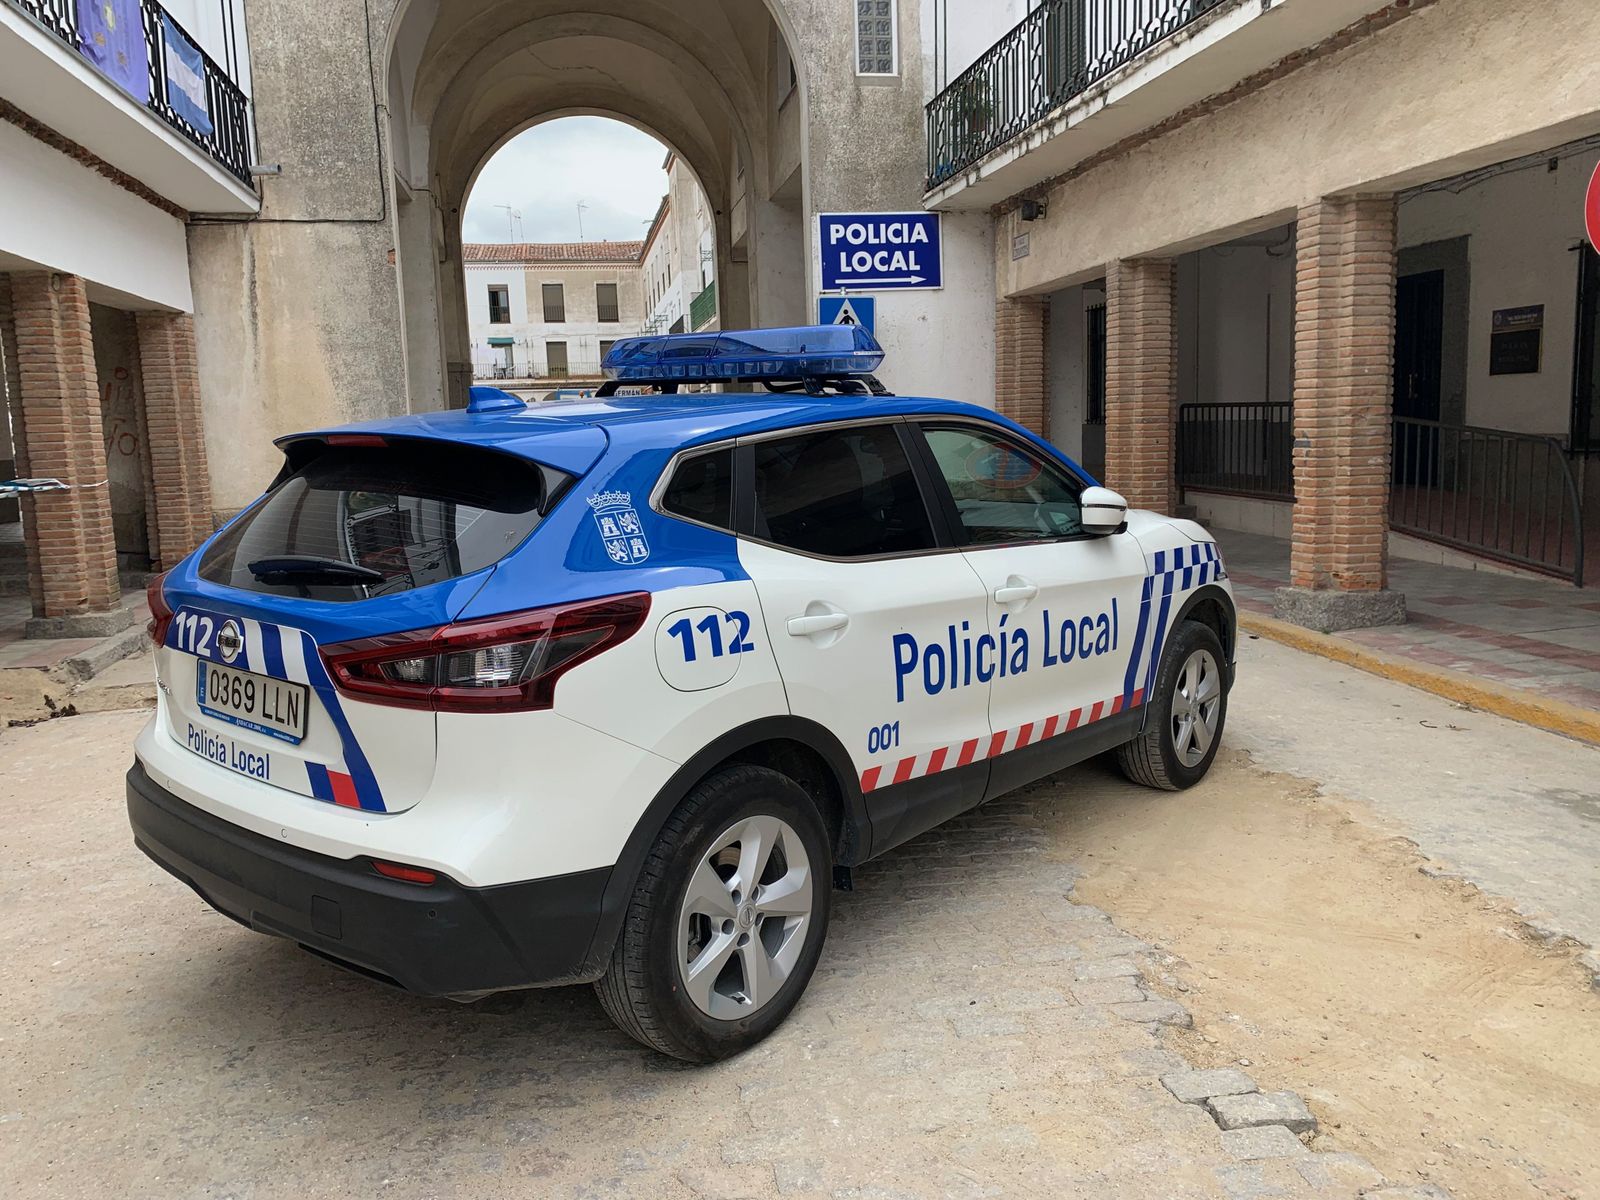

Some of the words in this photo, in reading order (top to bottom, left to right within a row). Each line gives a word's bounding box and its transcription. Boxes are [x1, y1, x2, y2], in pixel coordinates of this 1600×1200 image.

[829, 222, 929, 245] POLICIA
[840, 251, 921, 272] LOCAL
[175, 611, 214, 657] 112
[667, 610, 755, 662] 112
[892, 614, 1030, 702] Policía
[1042, 597, 1119, 668] Local
[210, 670, 255, 713] 0369
[262, 683, 299, 729] LLN
[187, 723, 227, 764] Policía
[231, 741, 270, 780] Local
[867, 720, 900, 754] 001
